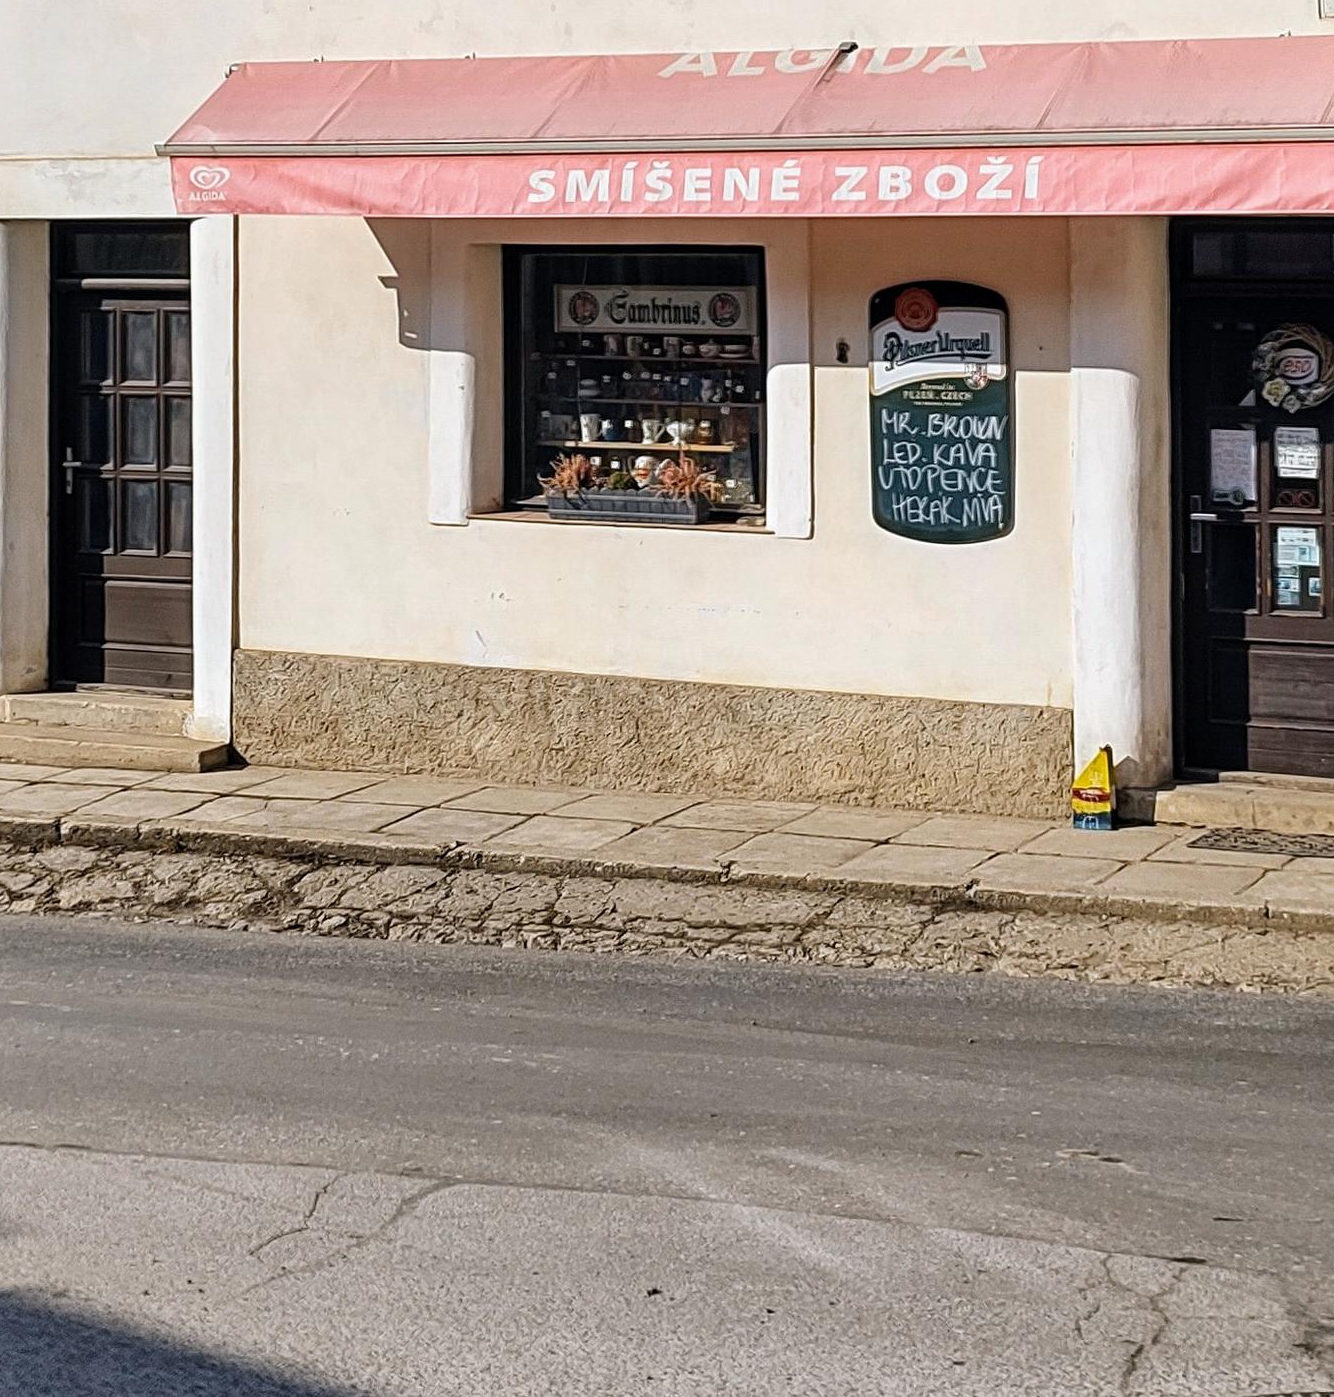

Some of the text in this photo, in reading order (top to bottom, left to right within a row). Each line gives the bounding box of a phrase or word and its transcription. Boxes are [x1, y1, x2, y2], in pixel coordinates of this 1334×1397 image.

[189, 191, 226, 201] ALGIDA
[528, 156, 1045, 203] SMÍŠENÉ ZBOŽÍ
[605, 287, 700, 326] Gambrinus
[883, 330, 990, 372] Pilsner Urquell
[928, 413, 1008, 440] BROWN
